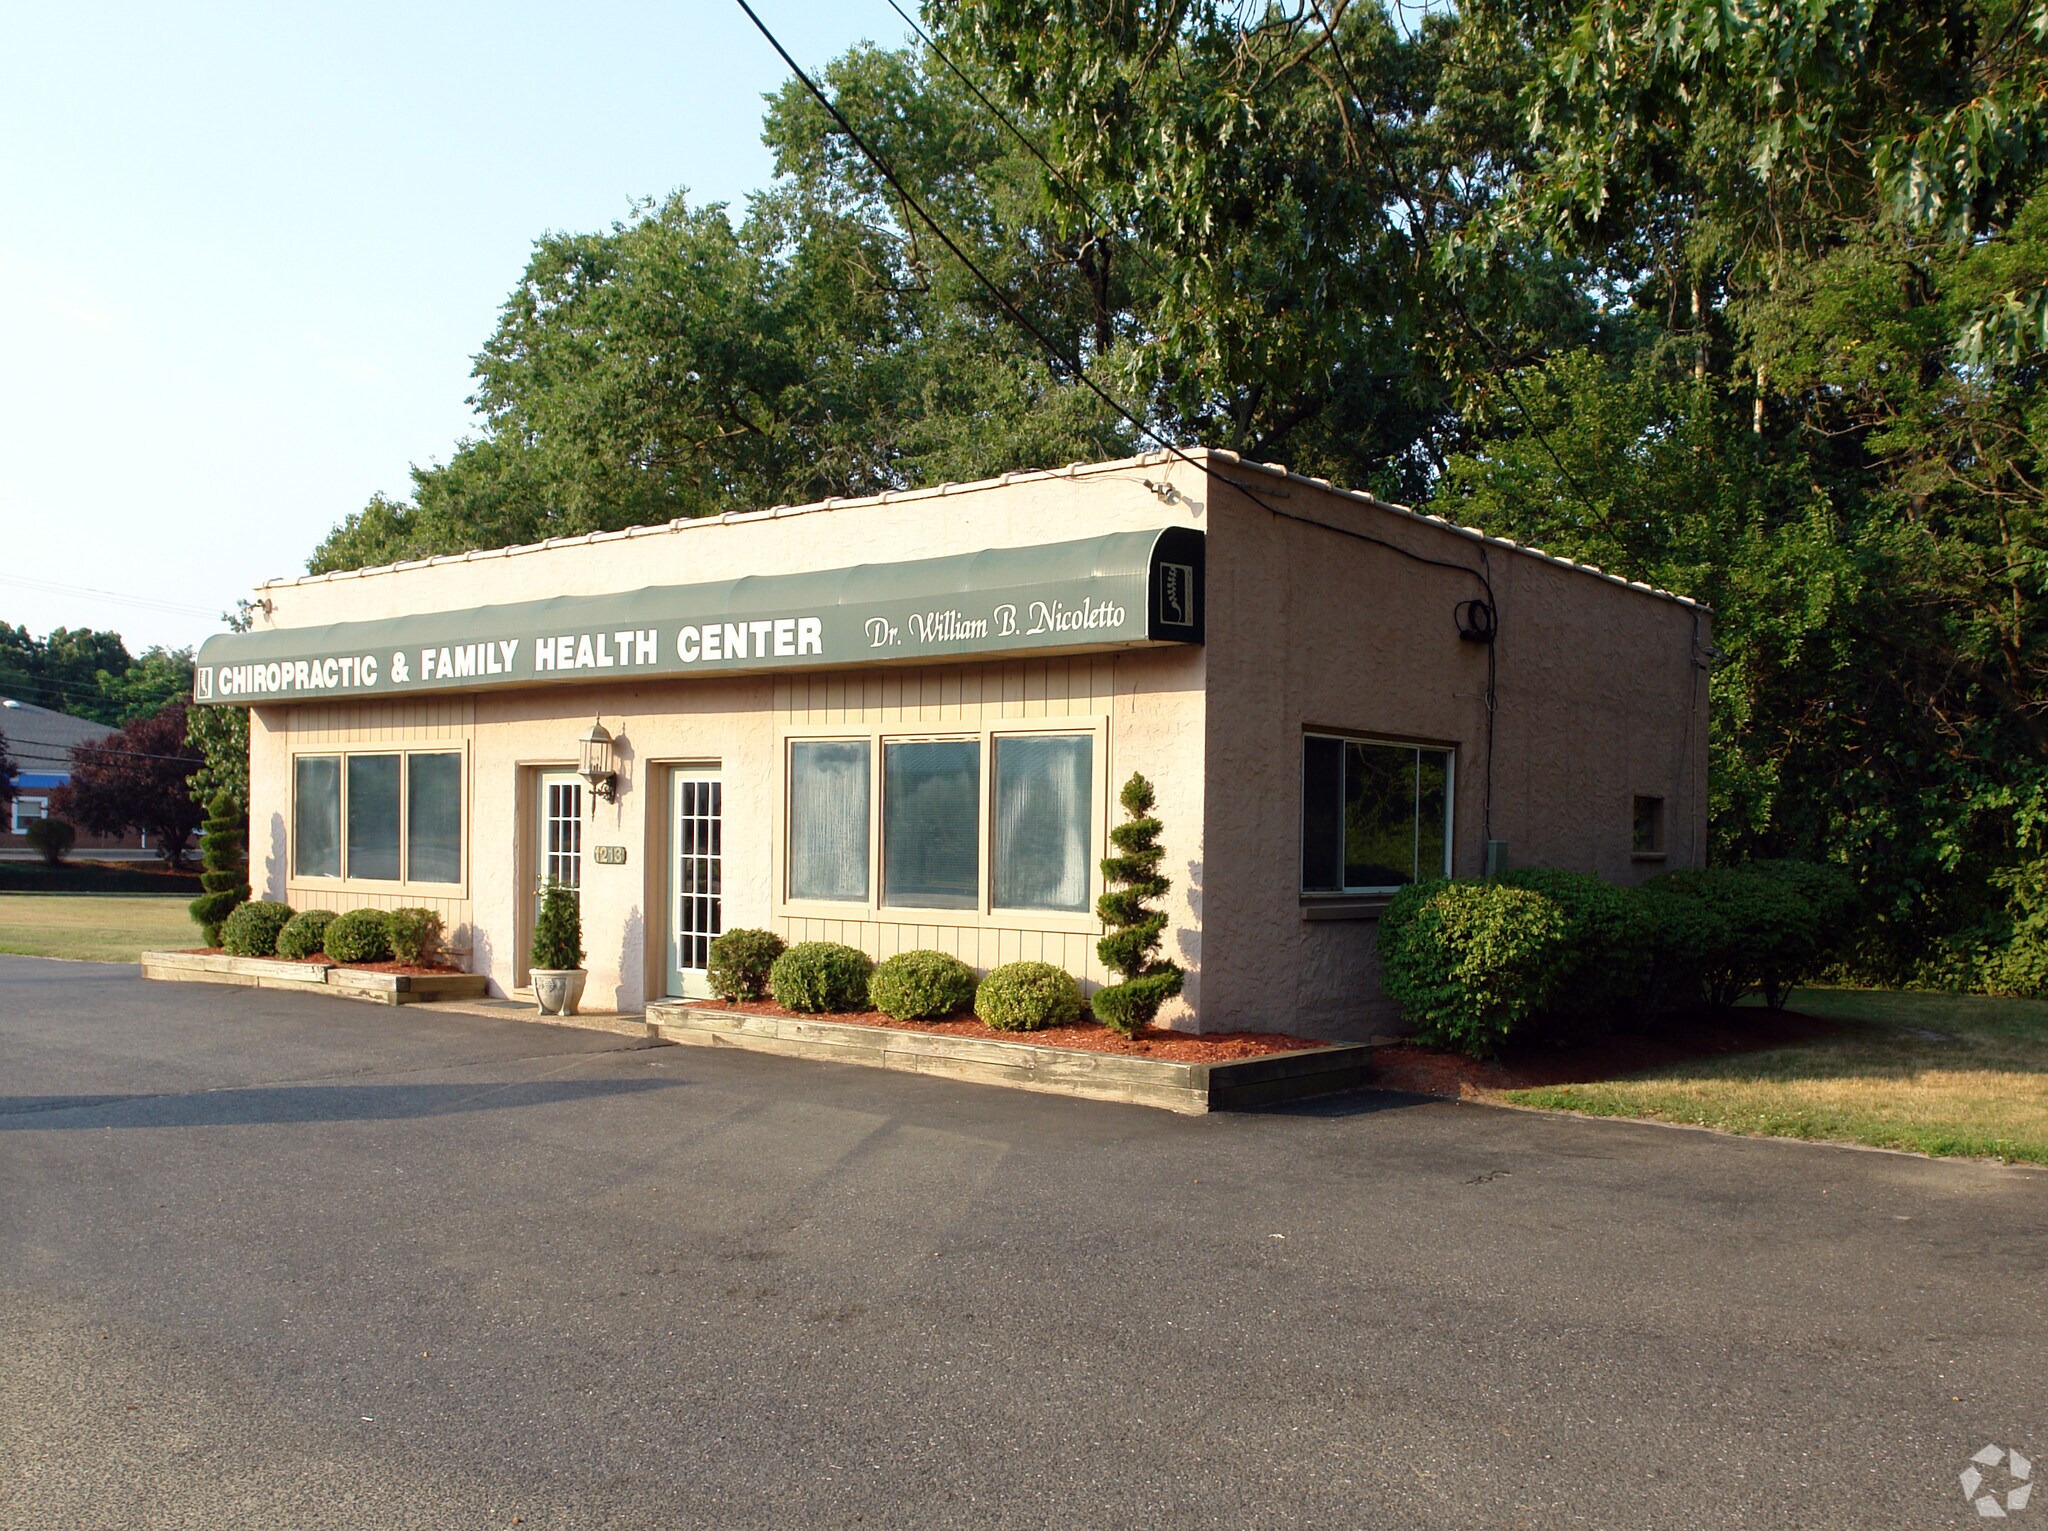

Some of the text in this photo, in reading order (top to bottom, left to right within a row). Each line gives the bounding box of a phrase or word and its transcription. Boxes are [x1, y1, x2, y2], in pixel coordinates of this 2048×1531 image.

[864, 596, 1126, 648] Dr. William B. Nicoletto
[218, 616, 823, 696] CHIROPRACTIC & FAMILY HEALTH CENTER
[595, 847, 622, 863] 1213
